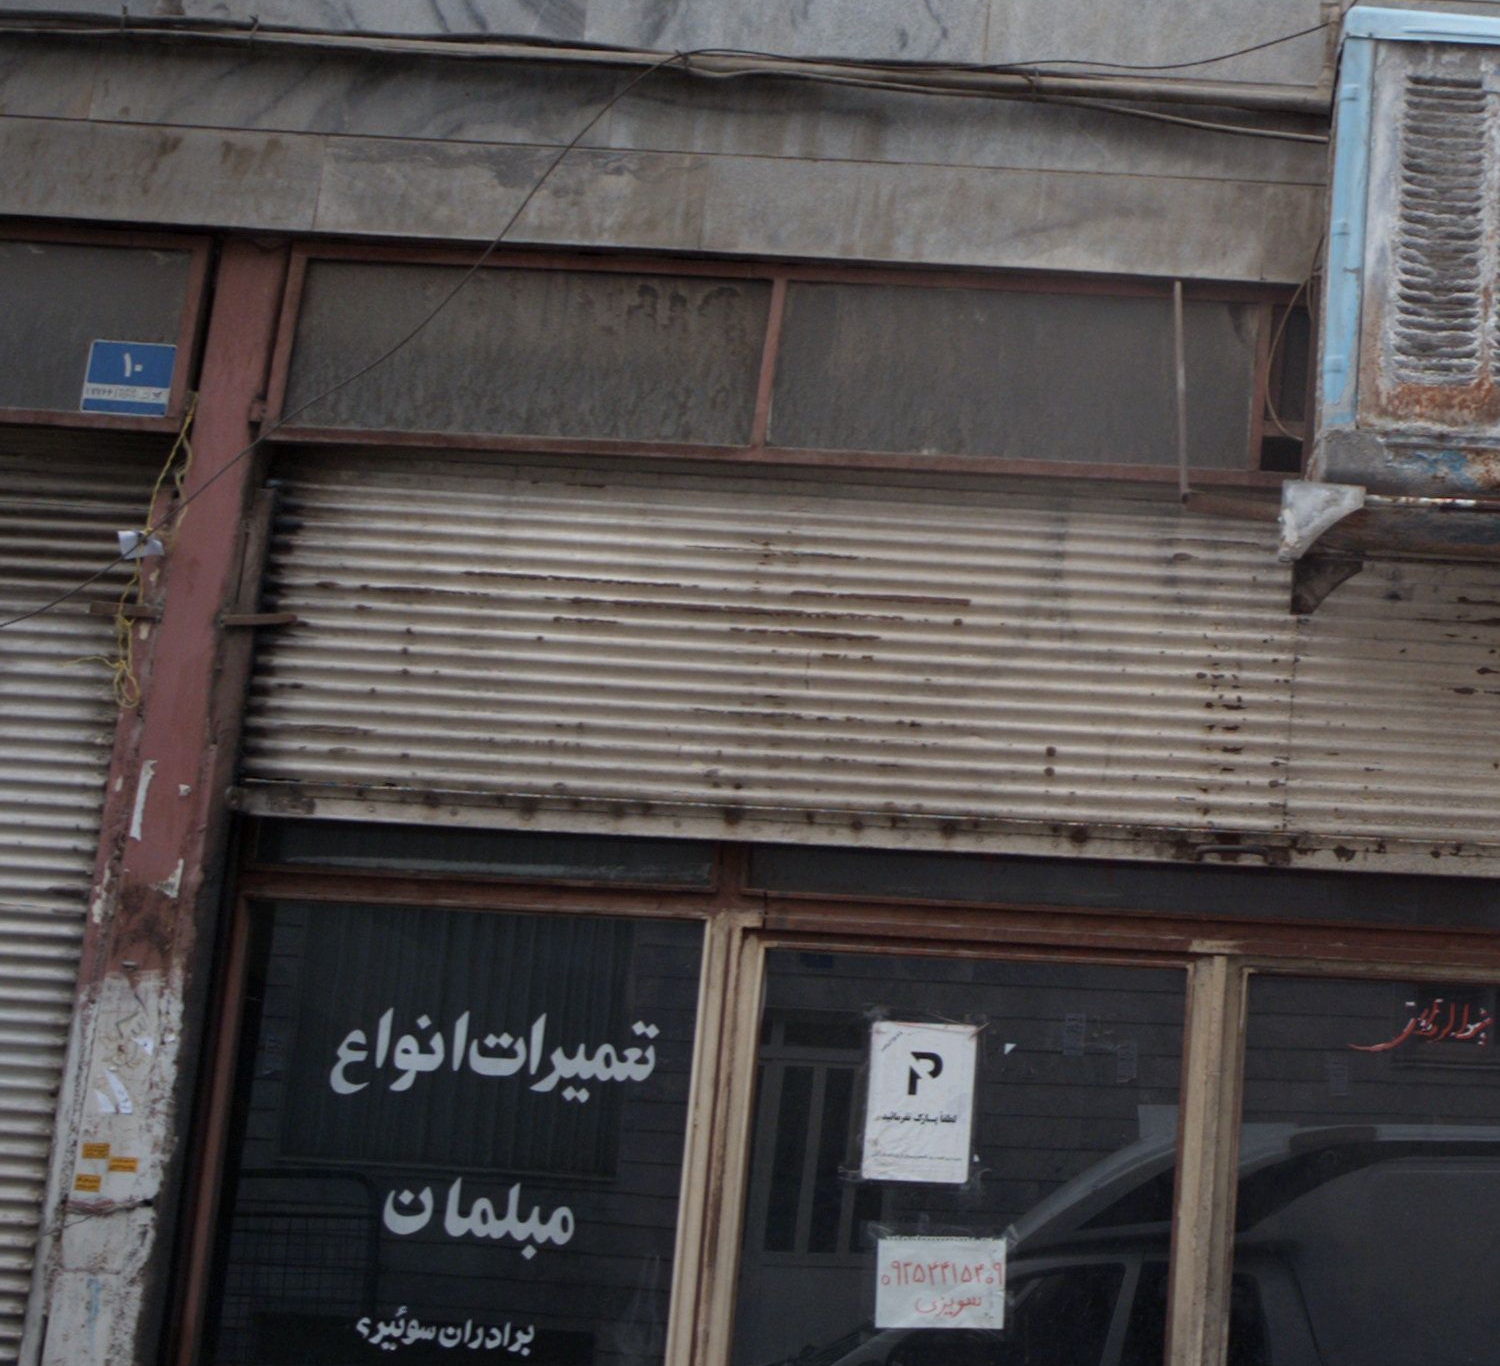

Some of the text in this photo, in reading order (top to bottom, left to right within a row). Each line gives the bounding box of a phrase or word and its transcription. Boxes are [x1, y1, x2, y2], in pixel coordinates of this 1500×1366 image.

[329, 1007, 661, 1104] تعمیرات انواع
[382, 1176, 576, 1260] مبلمان
[438, 1318, 536, 1356] برادران
